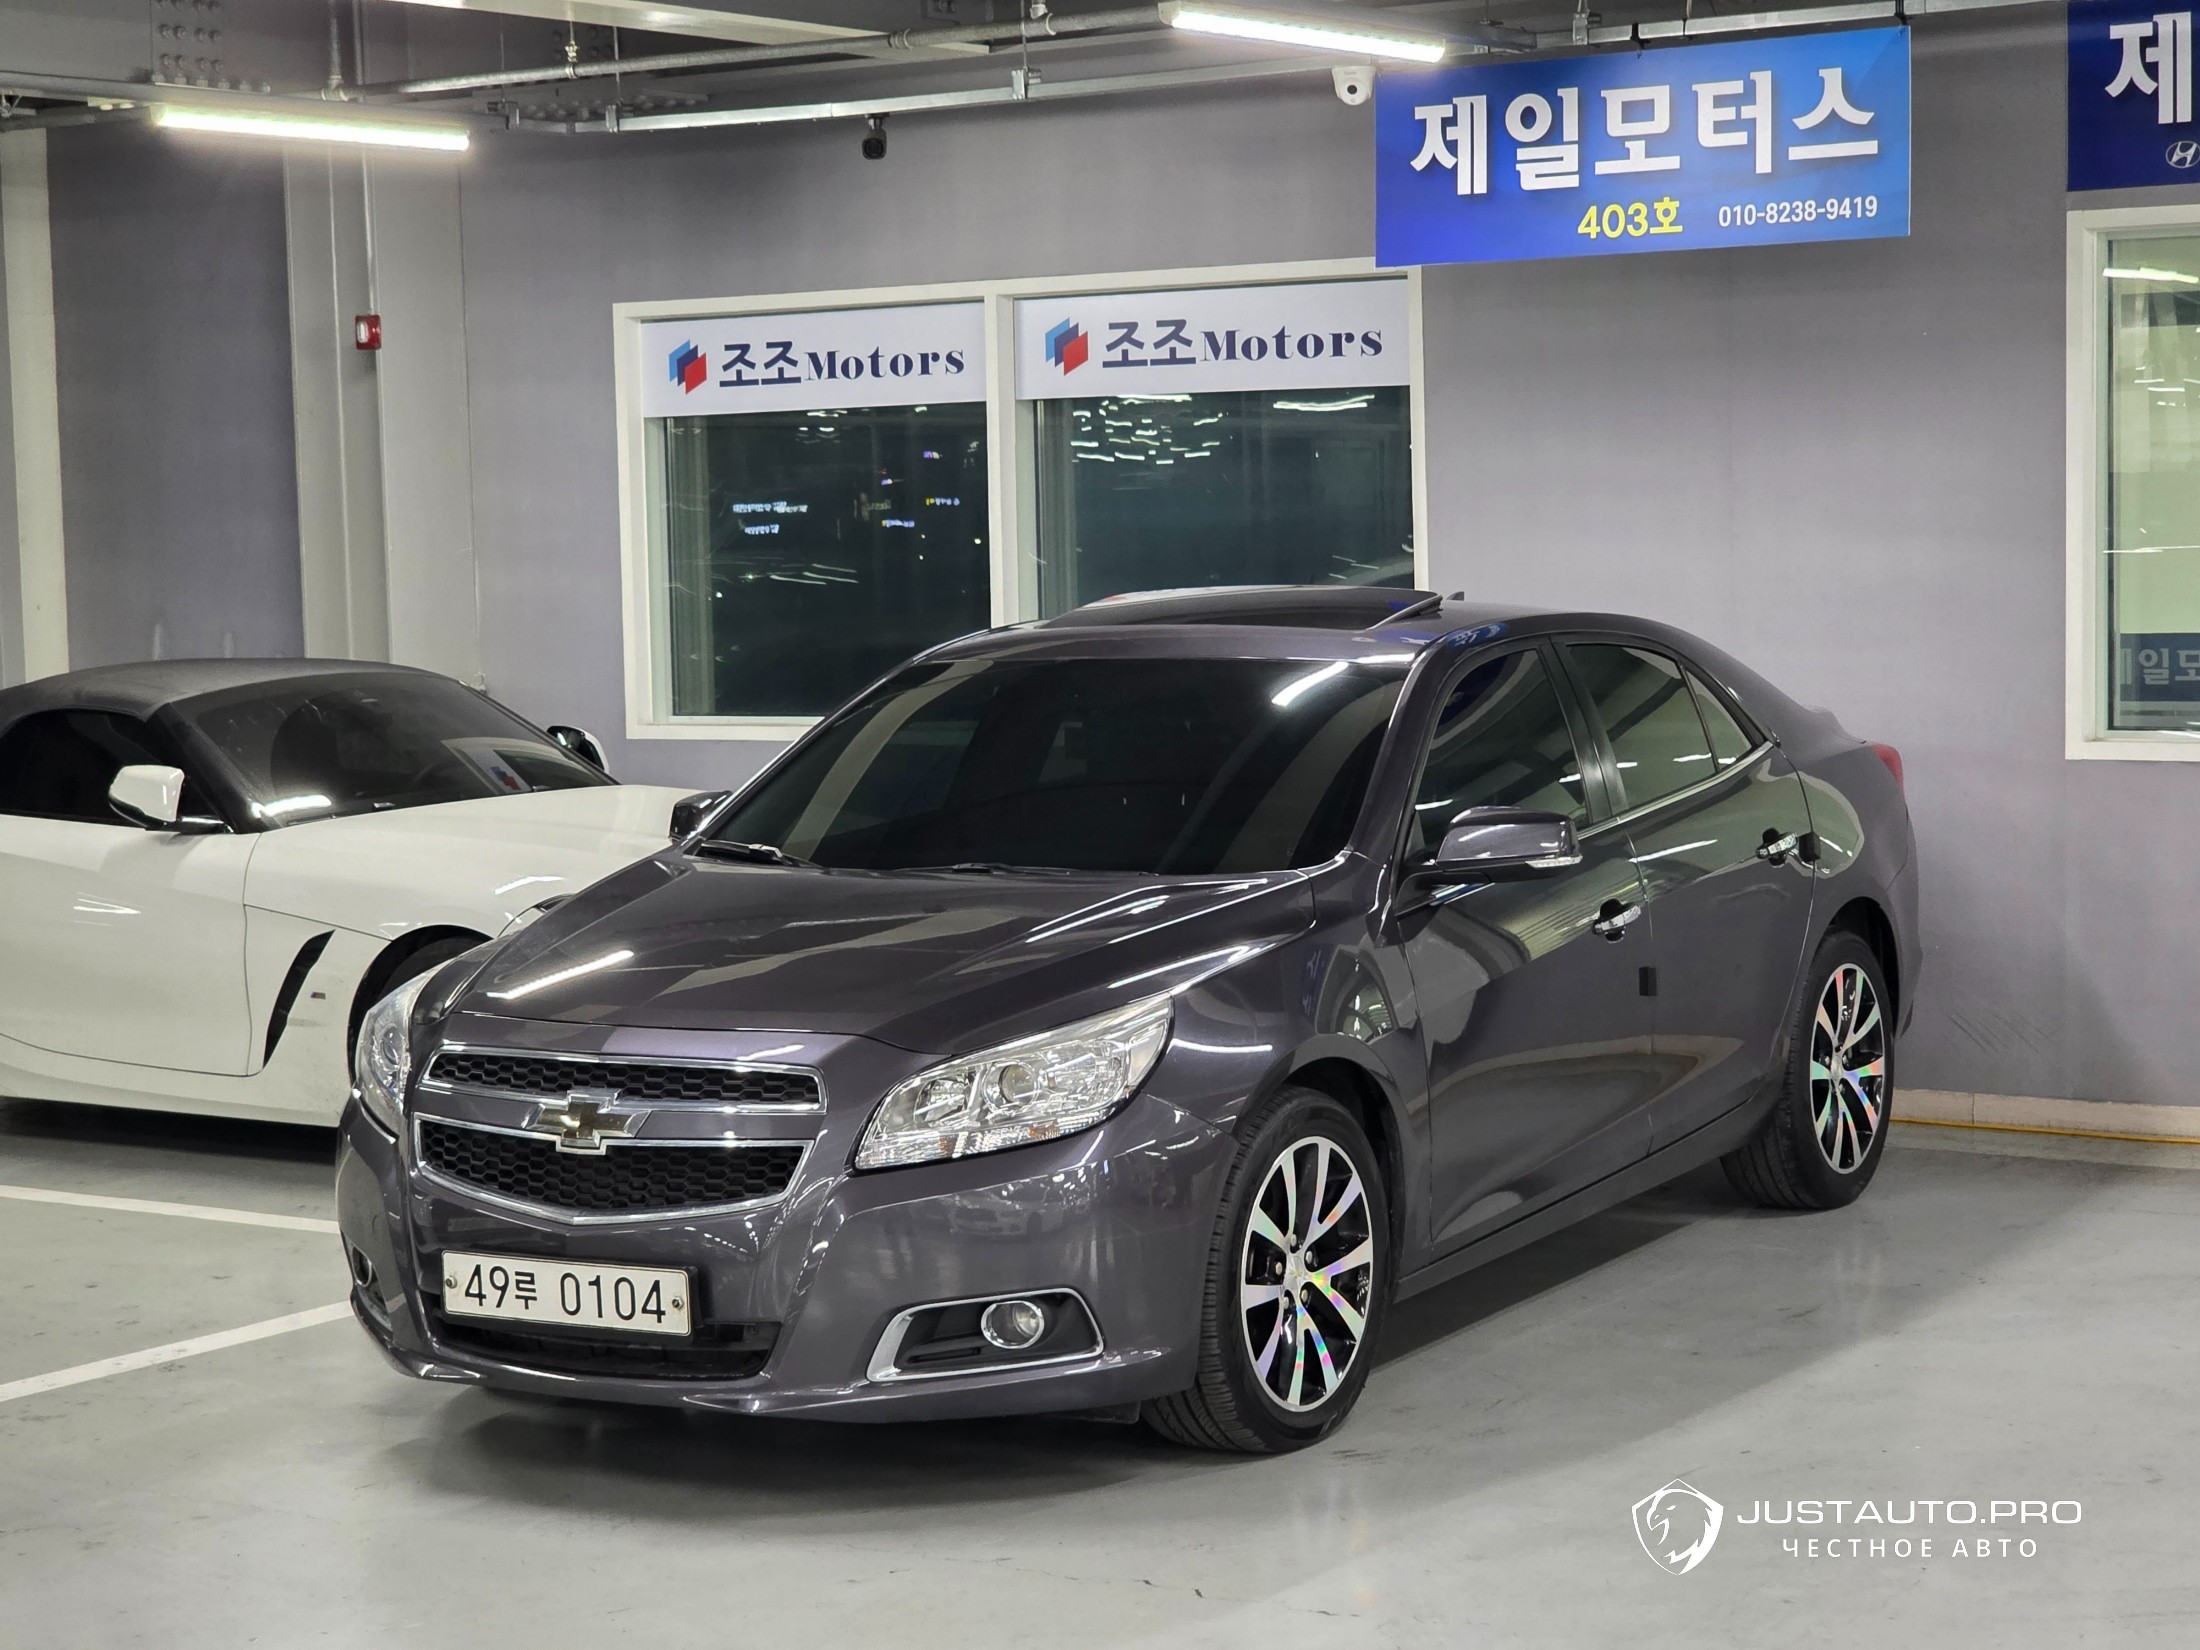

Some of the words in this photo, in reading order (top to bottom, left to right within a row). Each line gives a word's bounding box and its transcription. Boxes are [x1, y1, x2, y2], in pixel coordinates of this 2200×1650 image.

[2104, 11, 2192, 125] 제
[1410, 67, 1878, 196] 제일모터스
[1577, 196, 1683, 240] 403호
[1718, 195, 1879, 228] 010-8238-9419
[464, 1264, 537, 1310] 49루
[560, 1272, 666, 1324] 0104
